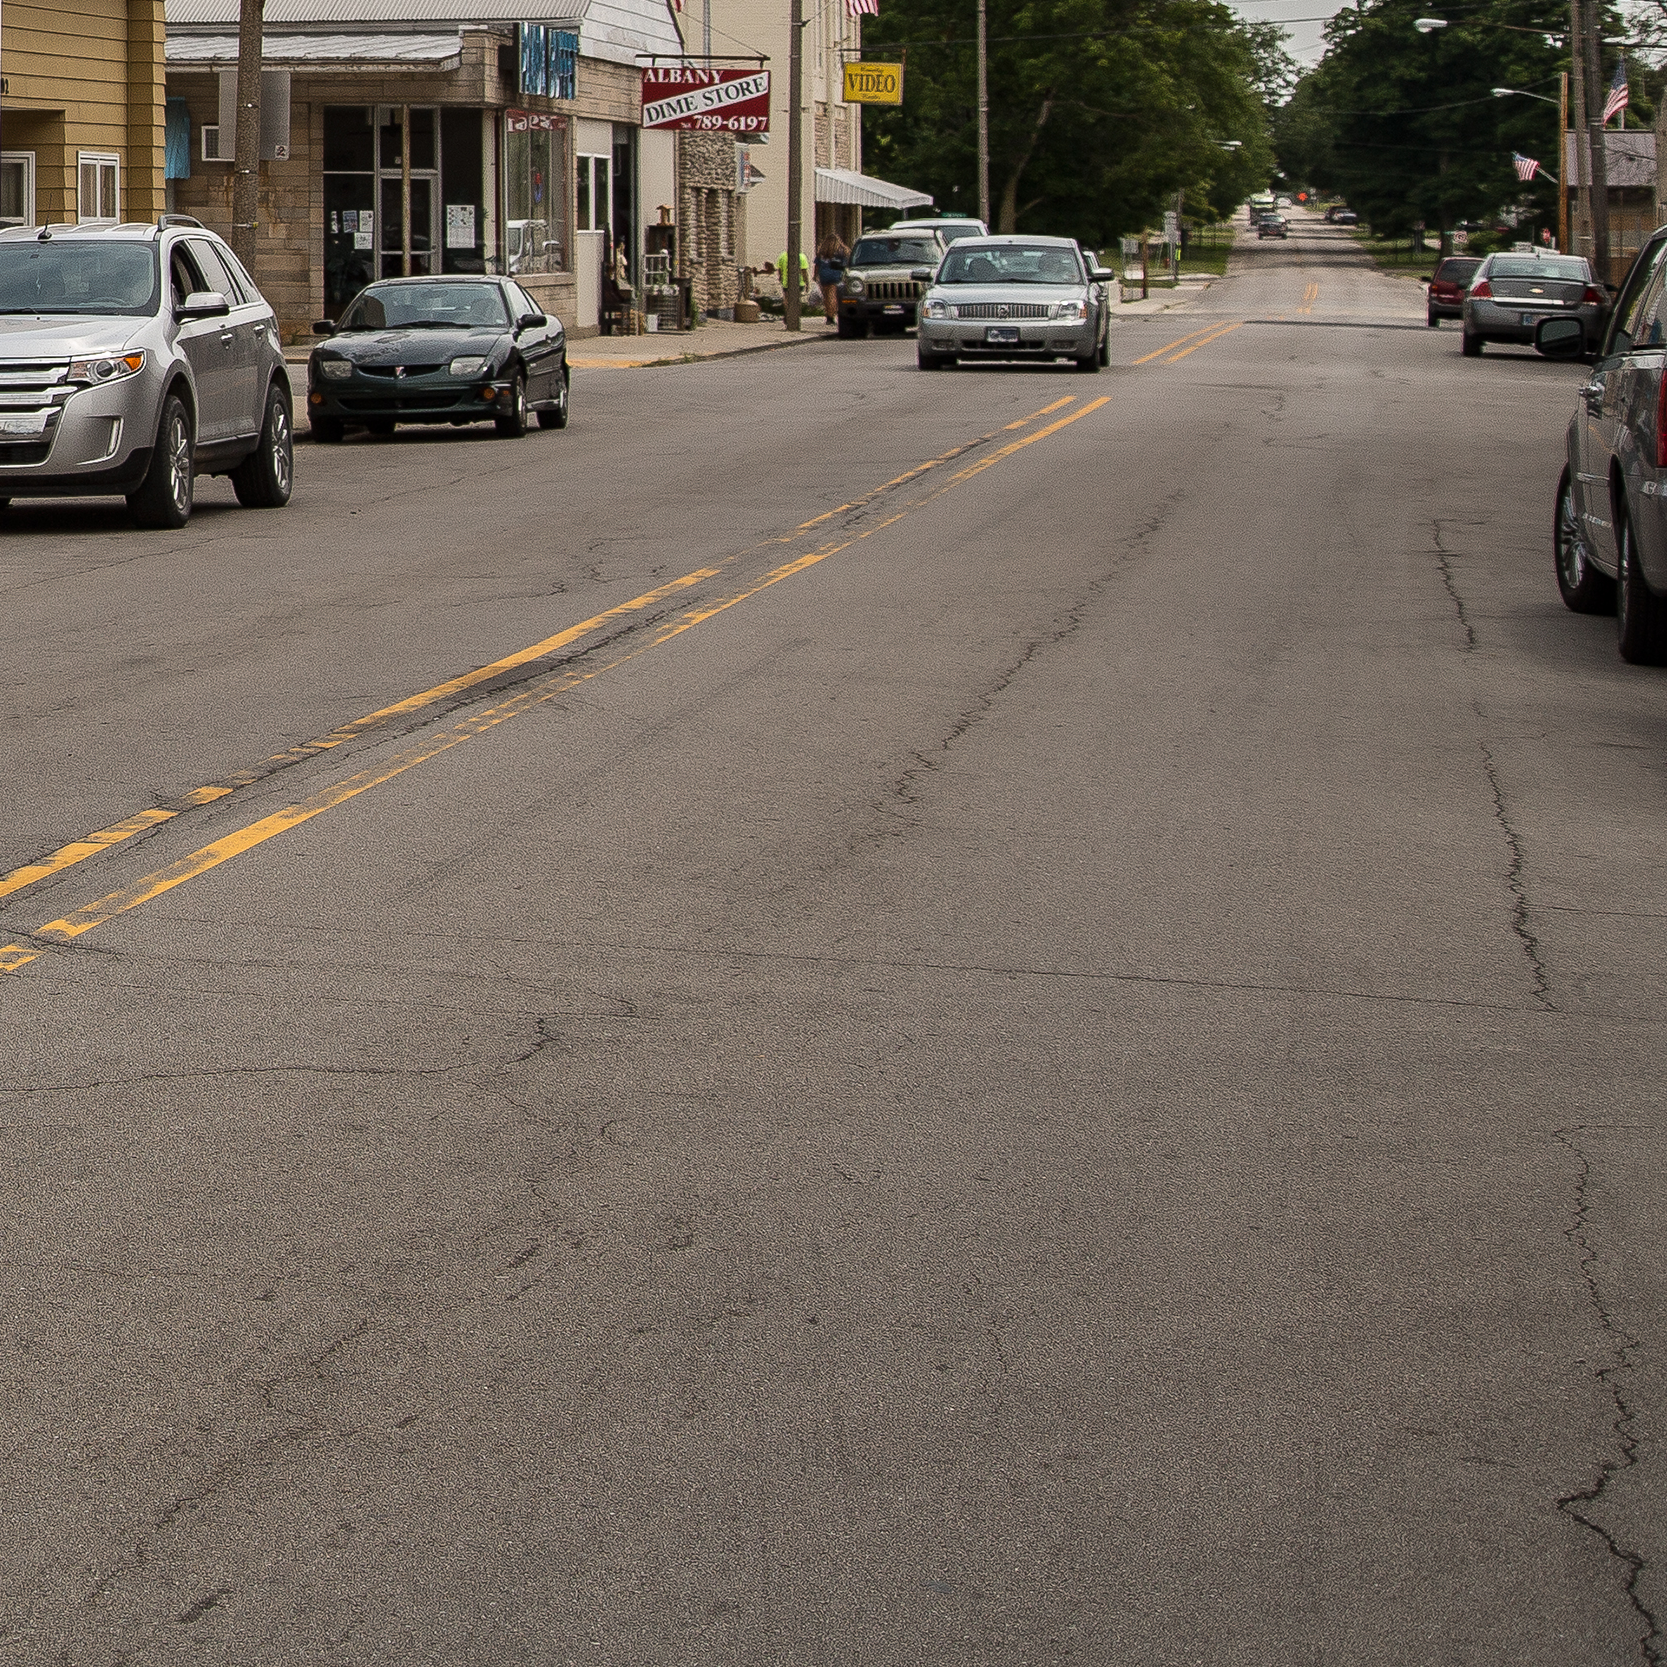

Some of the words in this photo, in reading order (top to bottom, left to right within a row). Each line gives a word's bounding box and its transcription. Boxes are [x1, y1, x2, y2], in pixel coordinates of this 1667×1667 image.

[643, 68, 724, 84] ALBANY
[848, 73, 896, 93] VIDEO
[645, 95, 698, 122] DIME
[702, 76, 768, 107] STORE
[692, 115, 768, 131] 789-6197
